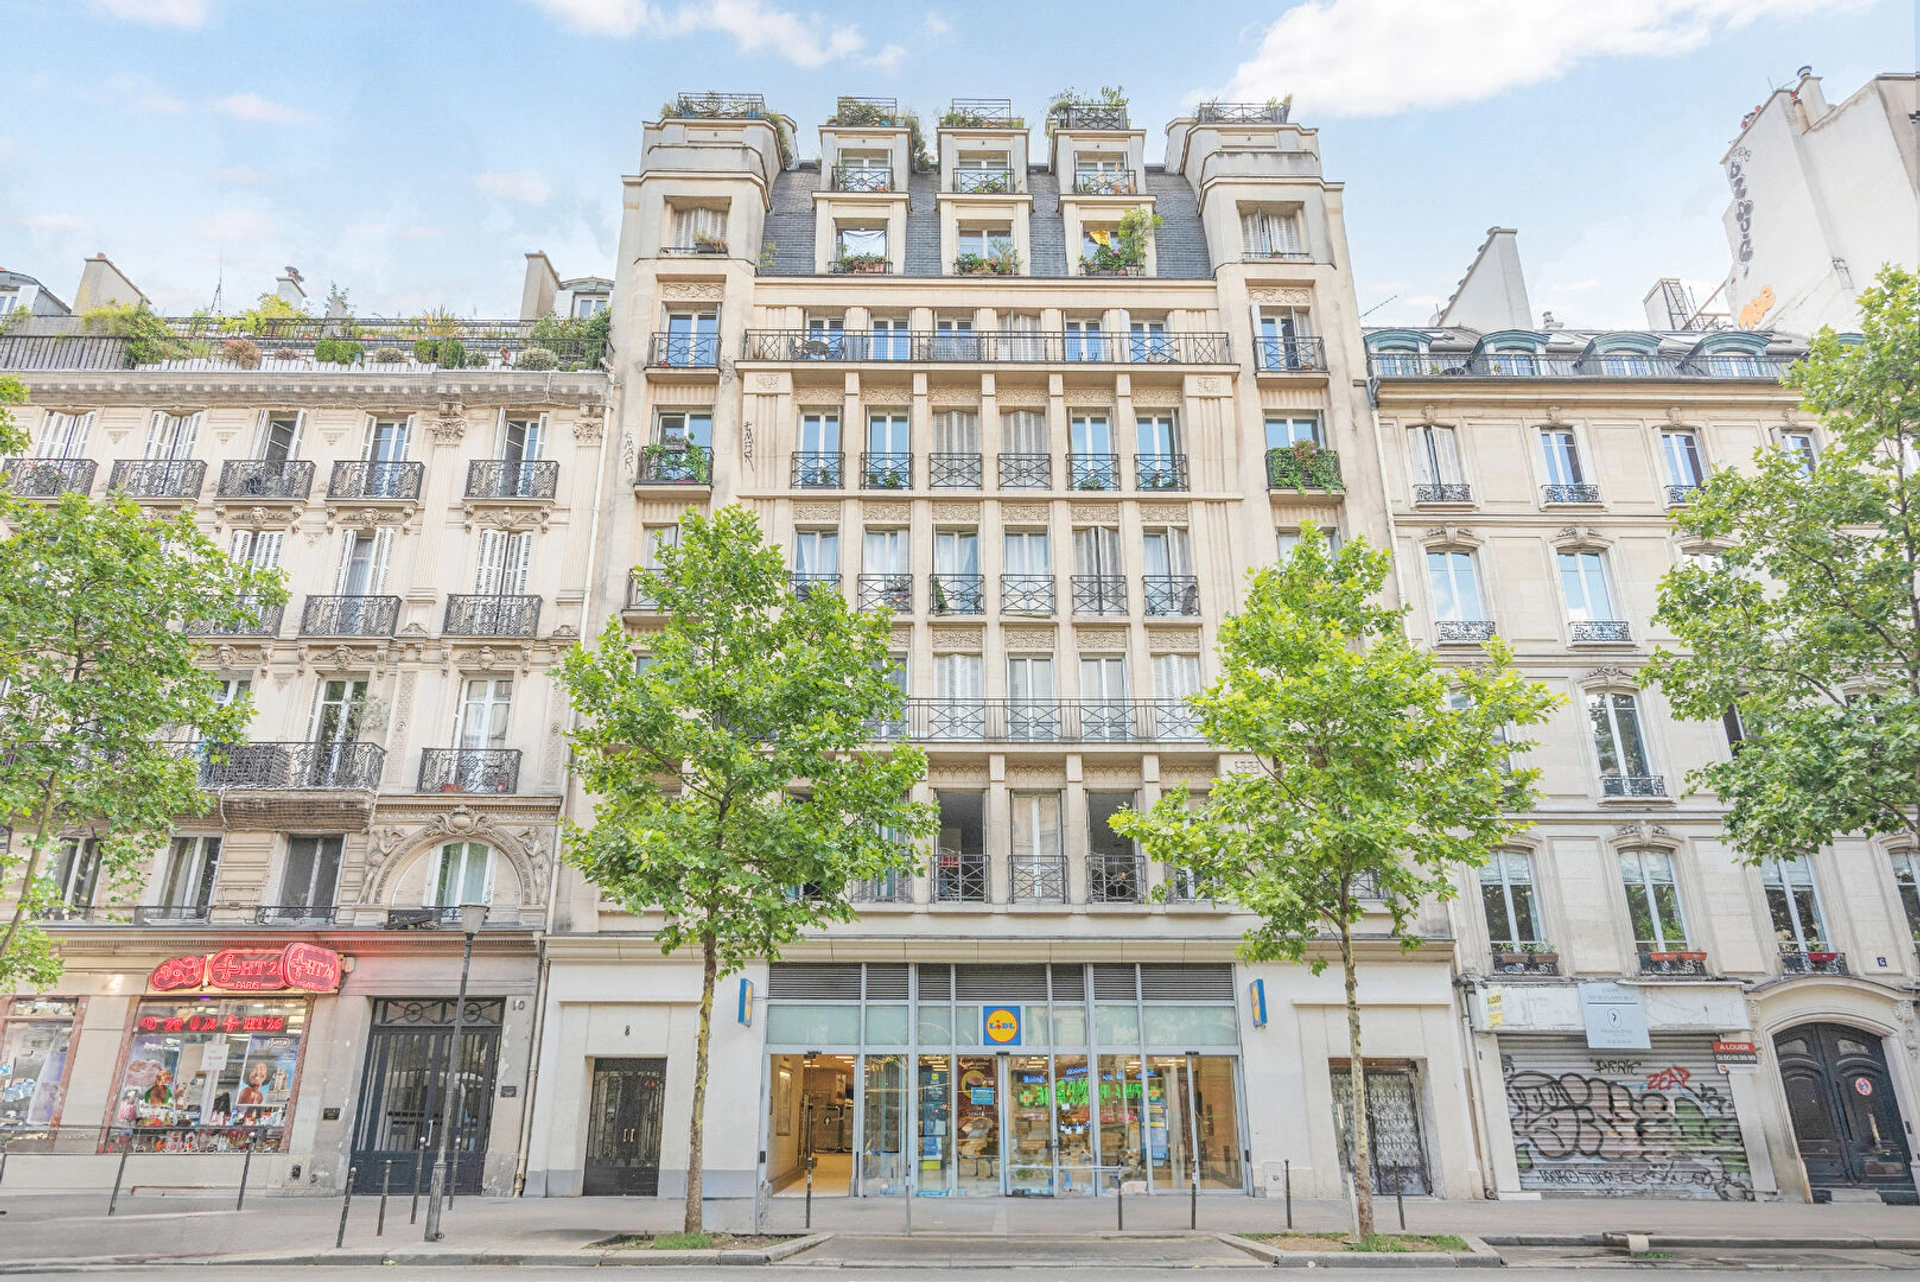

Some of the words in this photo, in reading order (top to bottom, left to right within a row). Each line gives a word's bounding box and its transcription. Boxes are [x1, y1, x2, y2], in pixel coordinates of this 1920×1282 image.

[512, 1000, 525, 1011] 10
[624, 1025, 631, 1036] 8
[1725, 1043, 1749, 1051] LOUER
